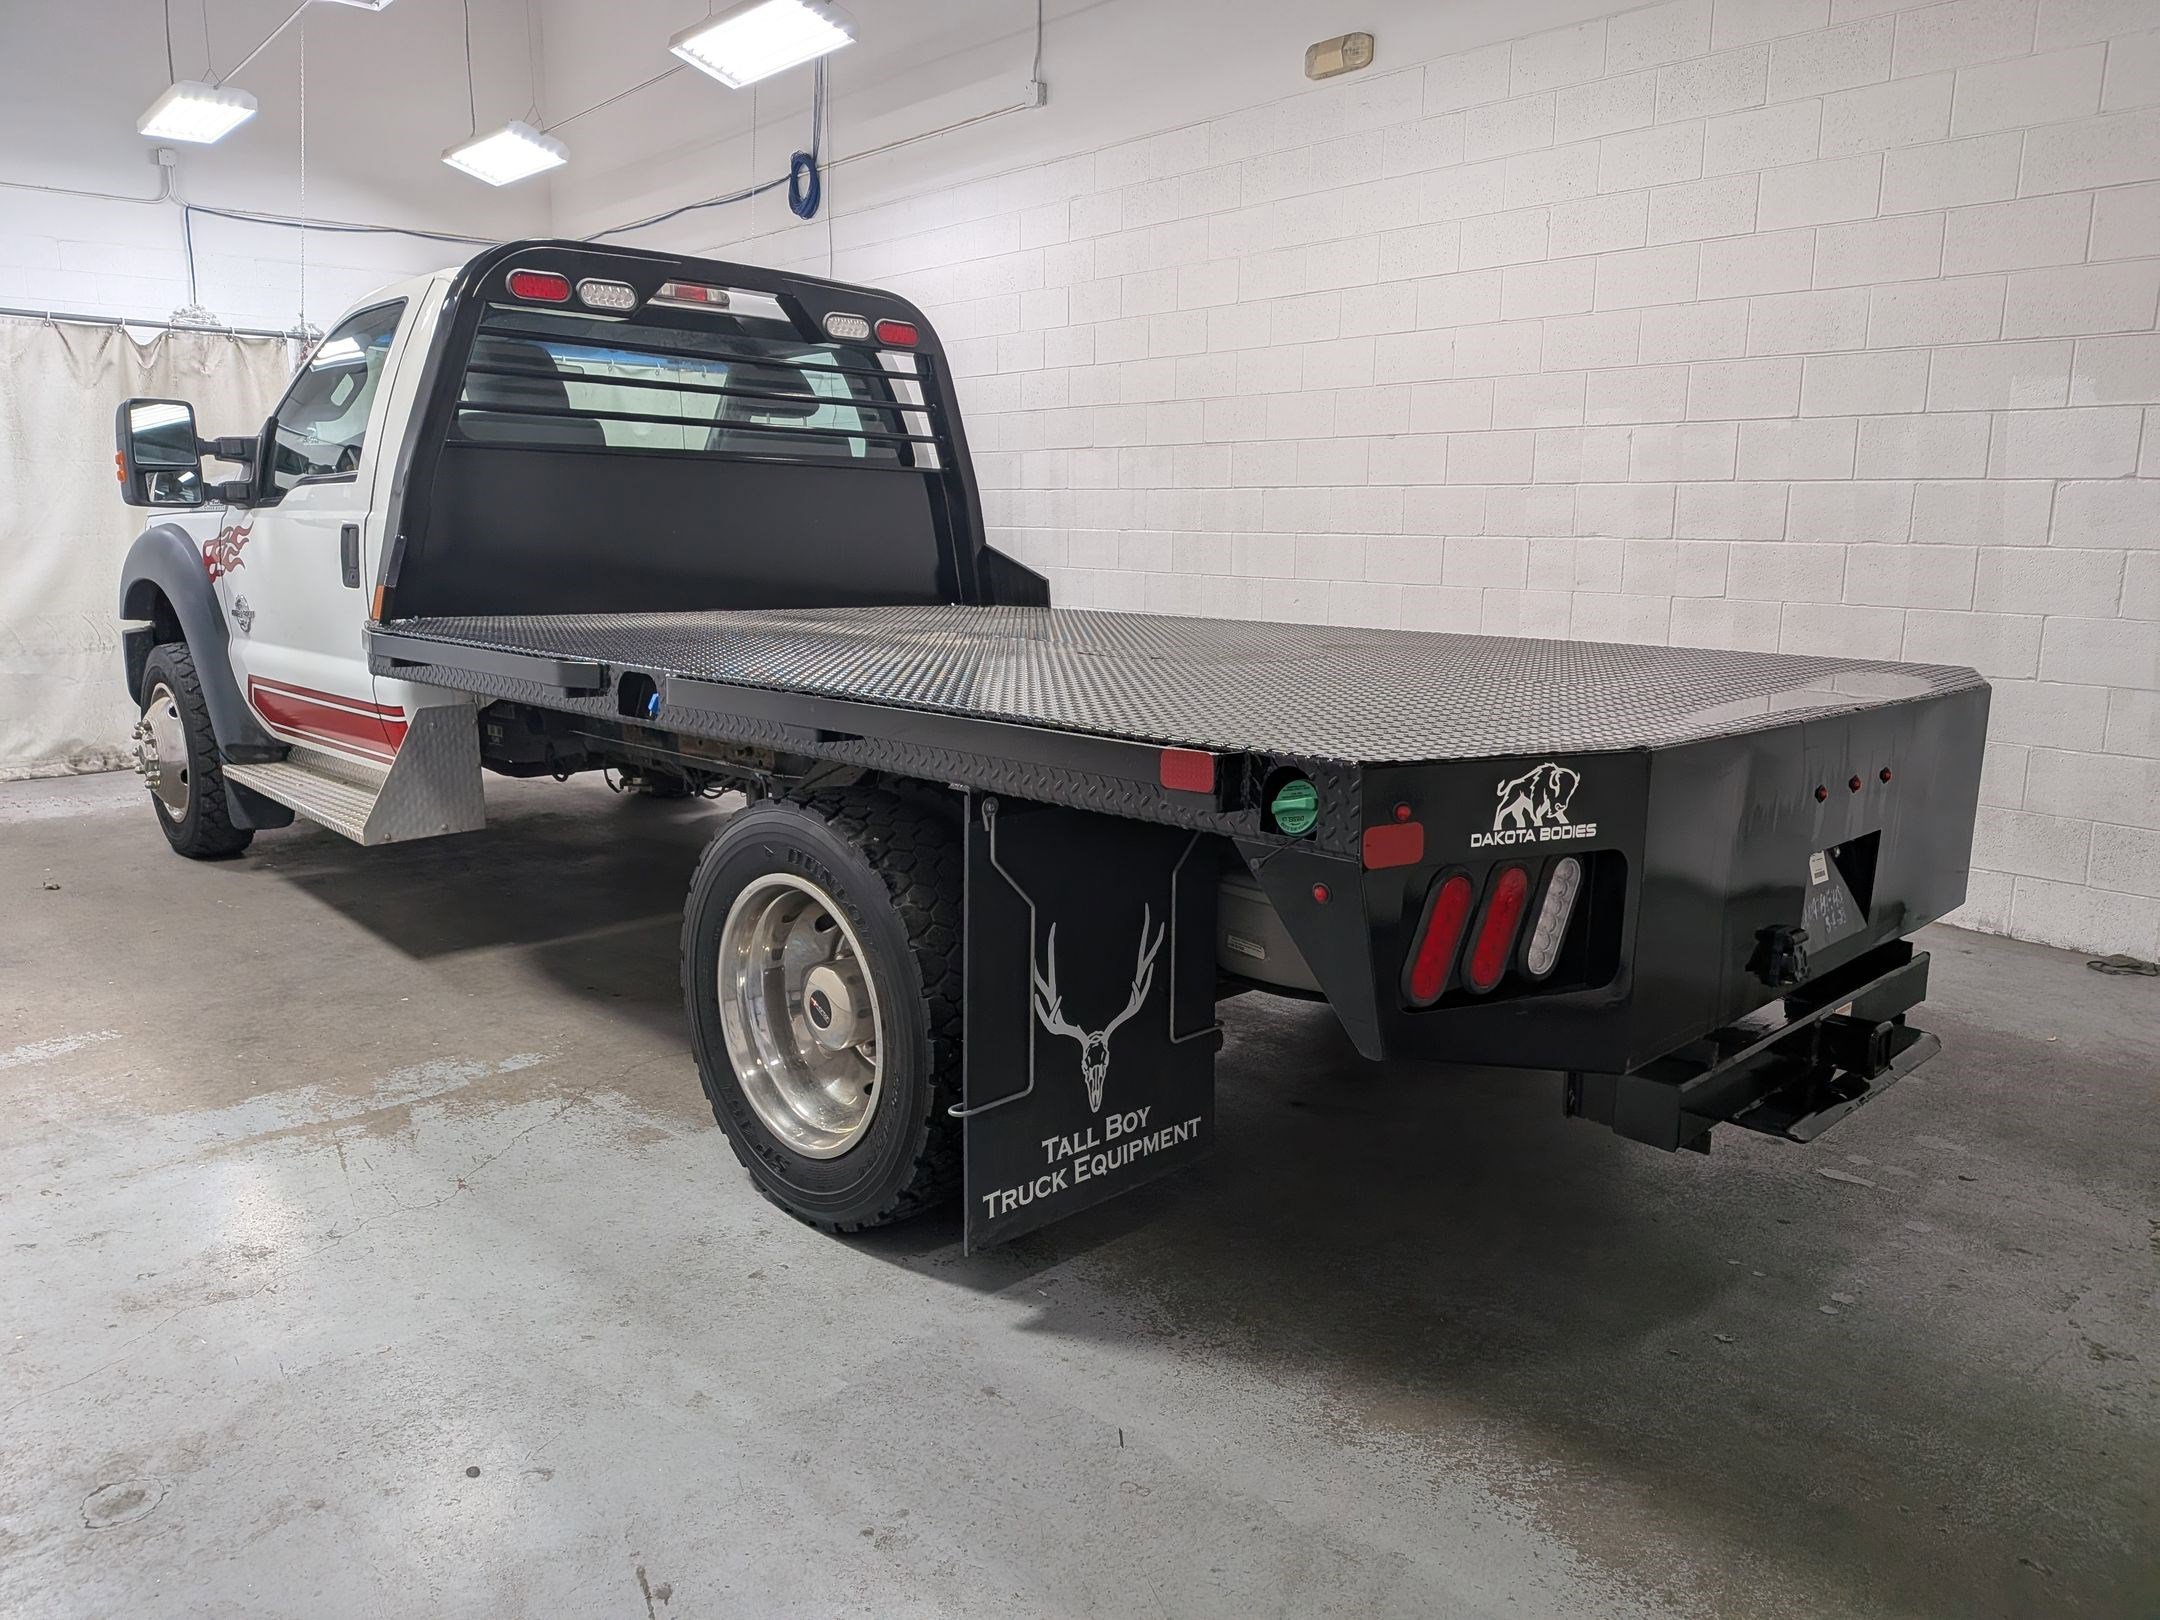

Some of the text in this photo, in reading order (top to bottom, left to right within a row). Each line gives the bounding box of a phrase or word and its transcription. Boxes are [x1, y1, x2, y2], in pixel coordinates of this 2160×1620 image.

[1470, 823, 1597, 848] DAKOTA BODIES
[1041, 1105, 1152, 1164] TALL BOY
[982, 1116, 1201, 1220] TRUCK EQUIPMENT
